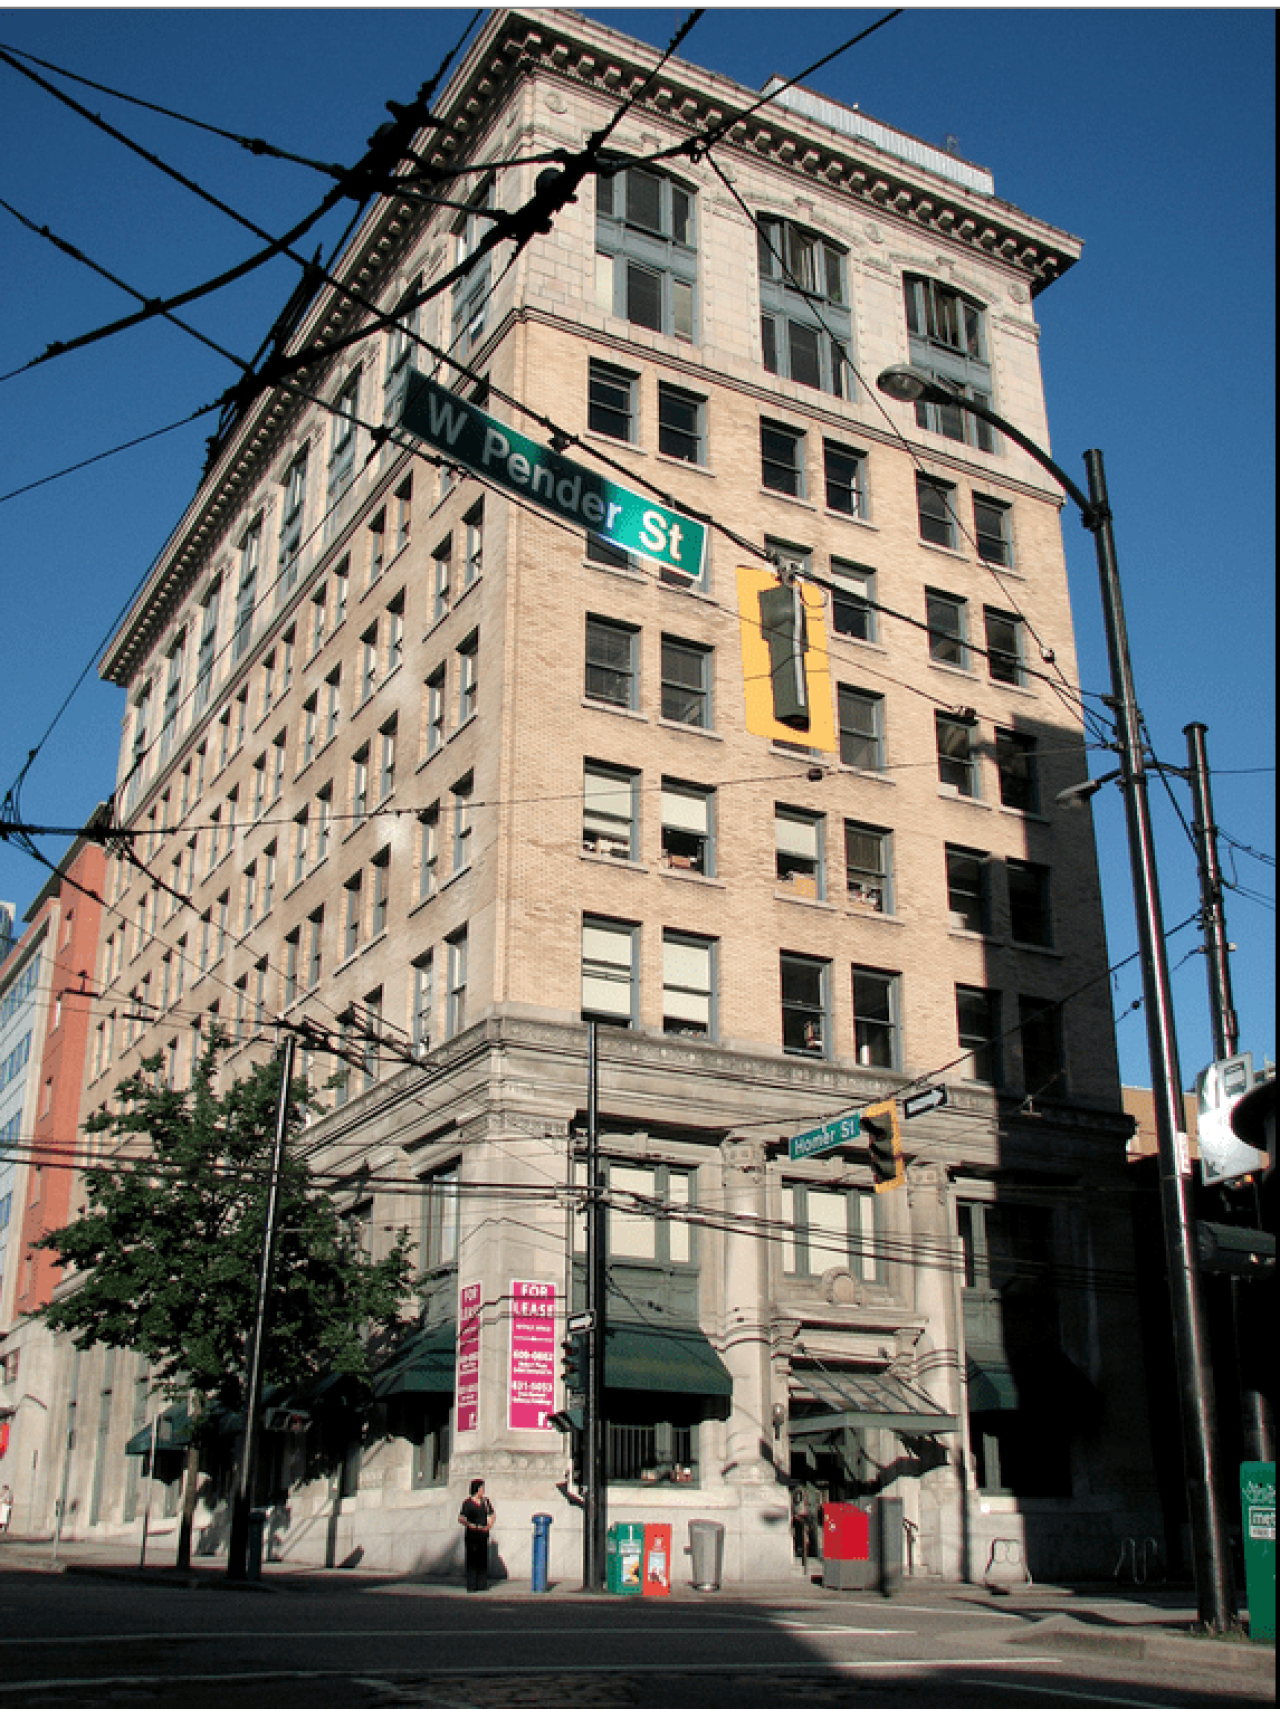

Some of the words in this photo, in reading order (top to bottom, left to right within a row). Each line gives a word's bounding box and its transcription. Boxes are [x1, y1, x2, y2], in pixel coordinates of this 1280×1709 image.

[428, 392, 469, 445] W
[481, 427, 622, 529] Pender
[638, 510, 684, 561] St
[522, 1284, 548, 1297] FOR
[513, 1302, 554, 1318] LEASE
